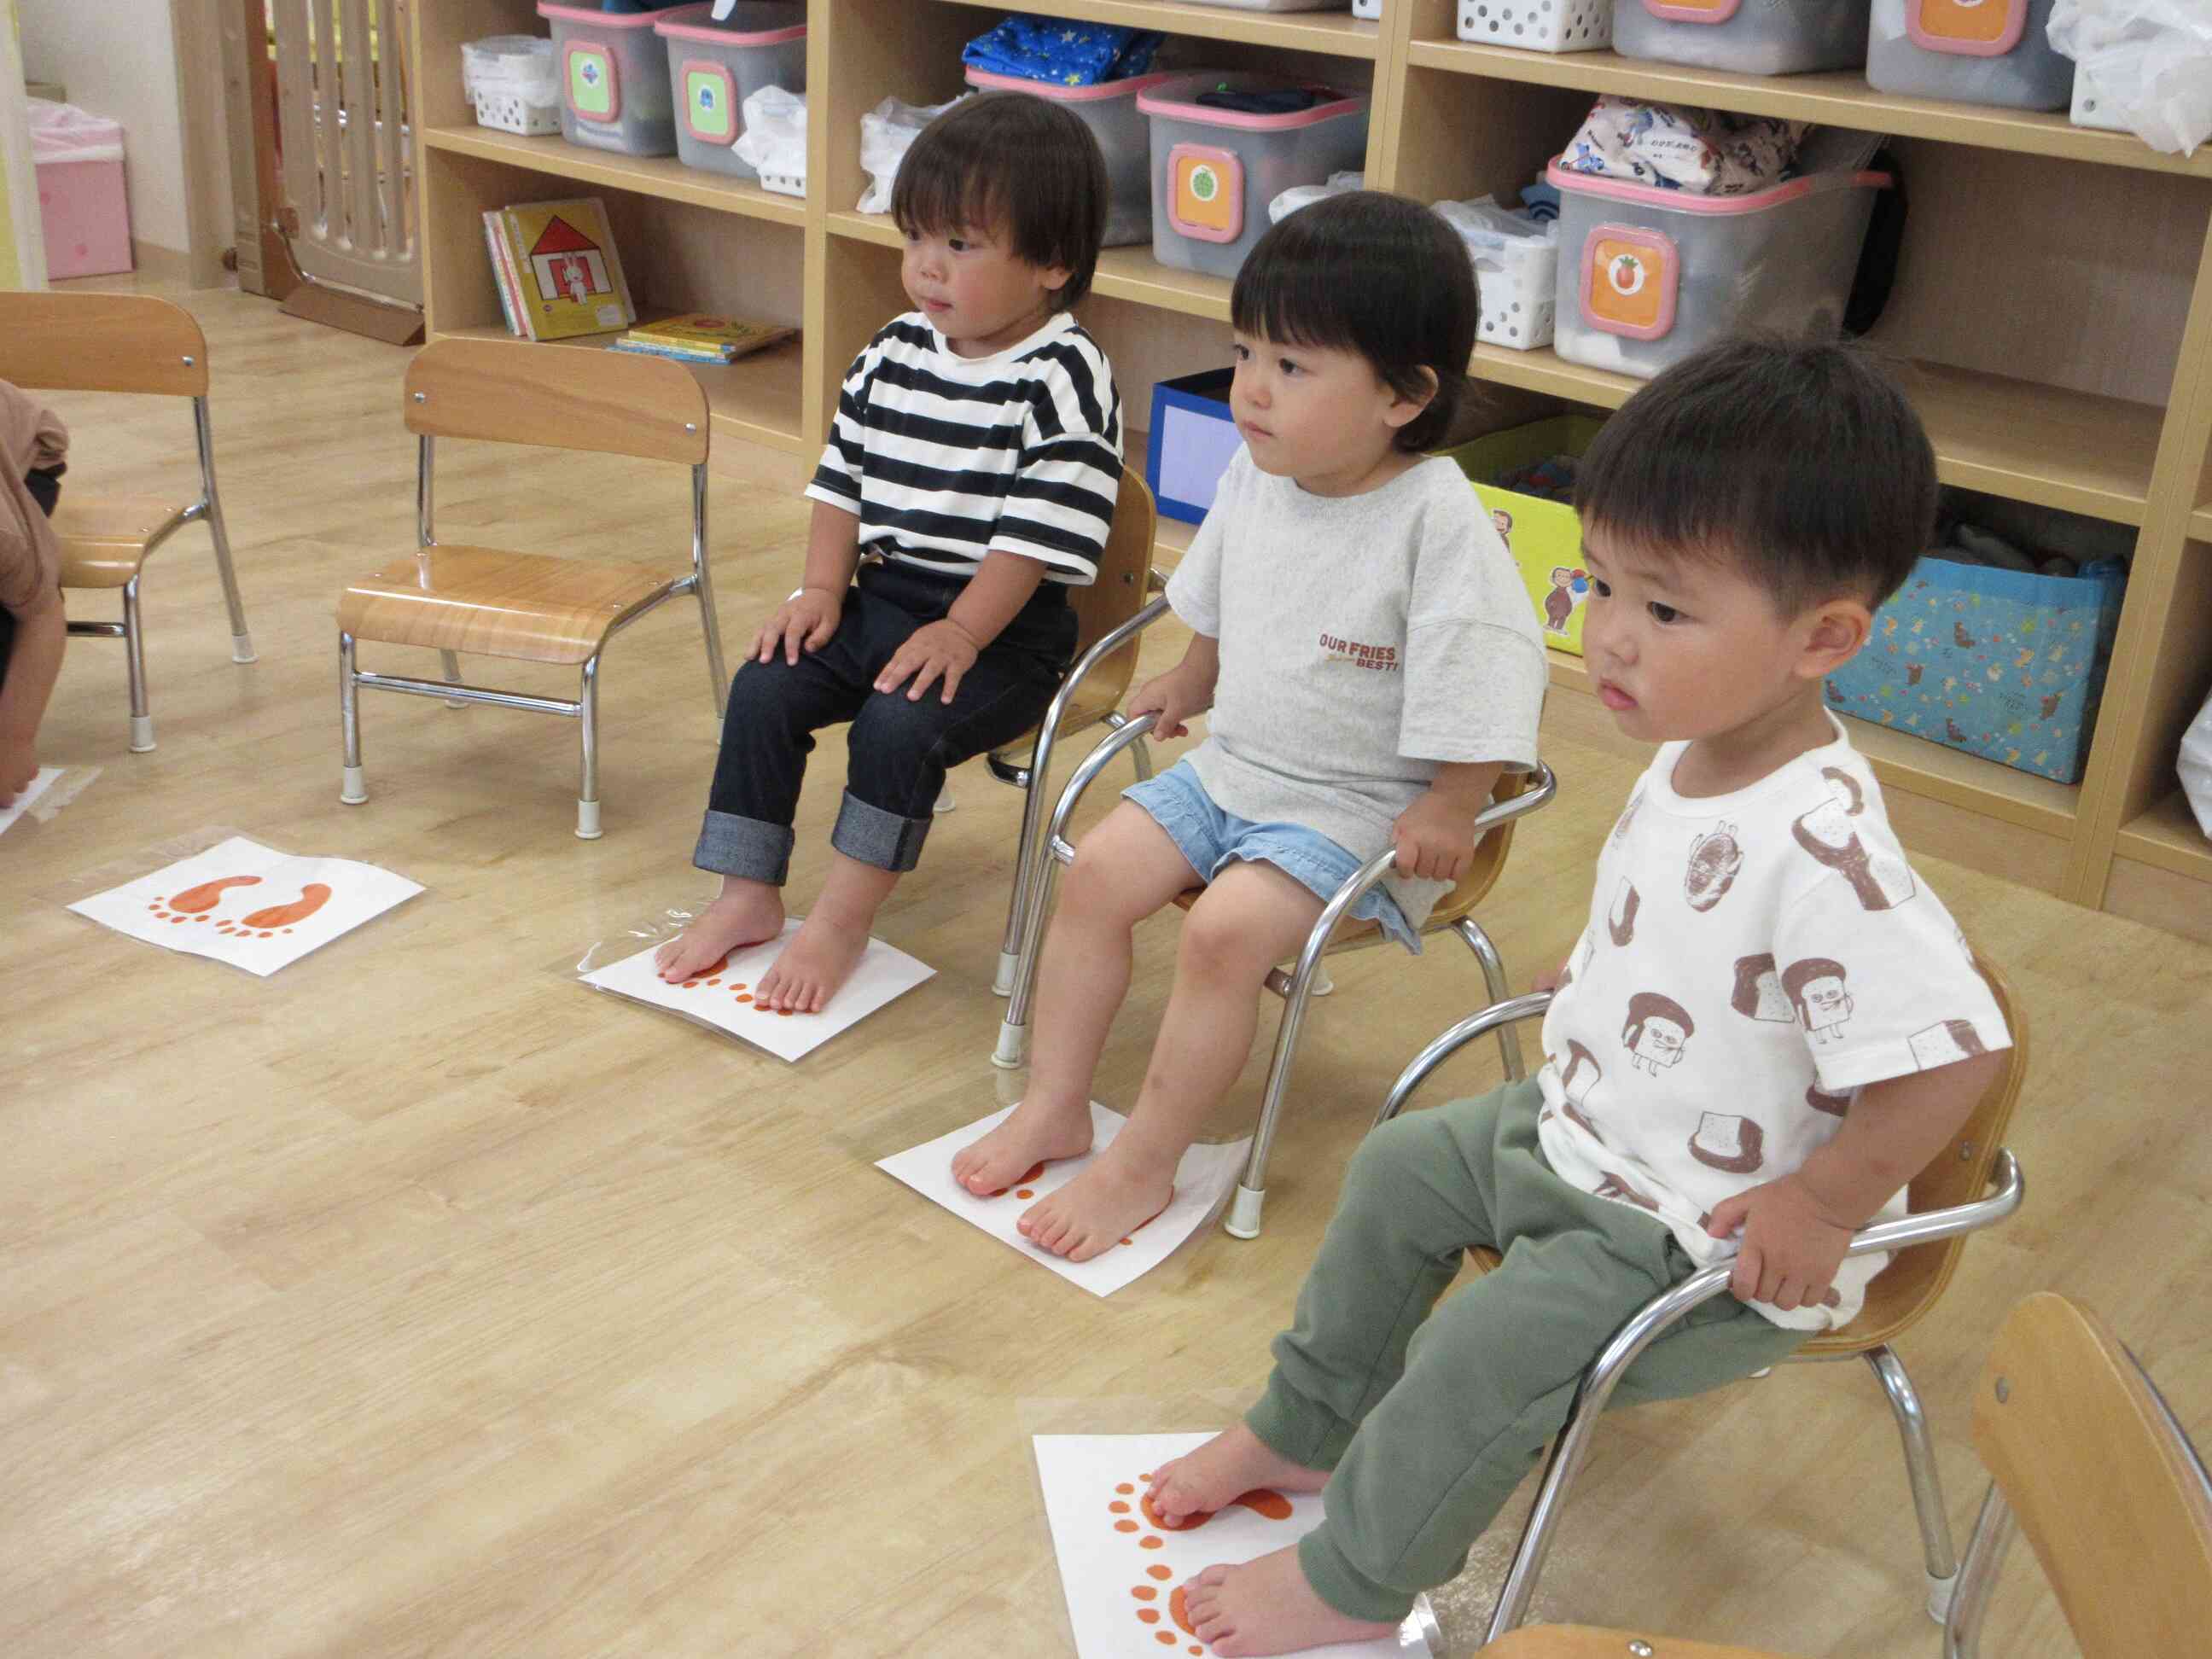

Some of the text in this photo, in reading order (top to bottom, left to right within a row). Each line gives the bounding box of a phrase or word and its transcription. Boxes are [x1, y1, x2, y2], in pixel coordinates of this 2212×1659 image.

[1319, 634, 1347, 653] OUR
[1348, 642, 1394, 661] FRIES
[1356, 658, 1399, 672] BEST!
